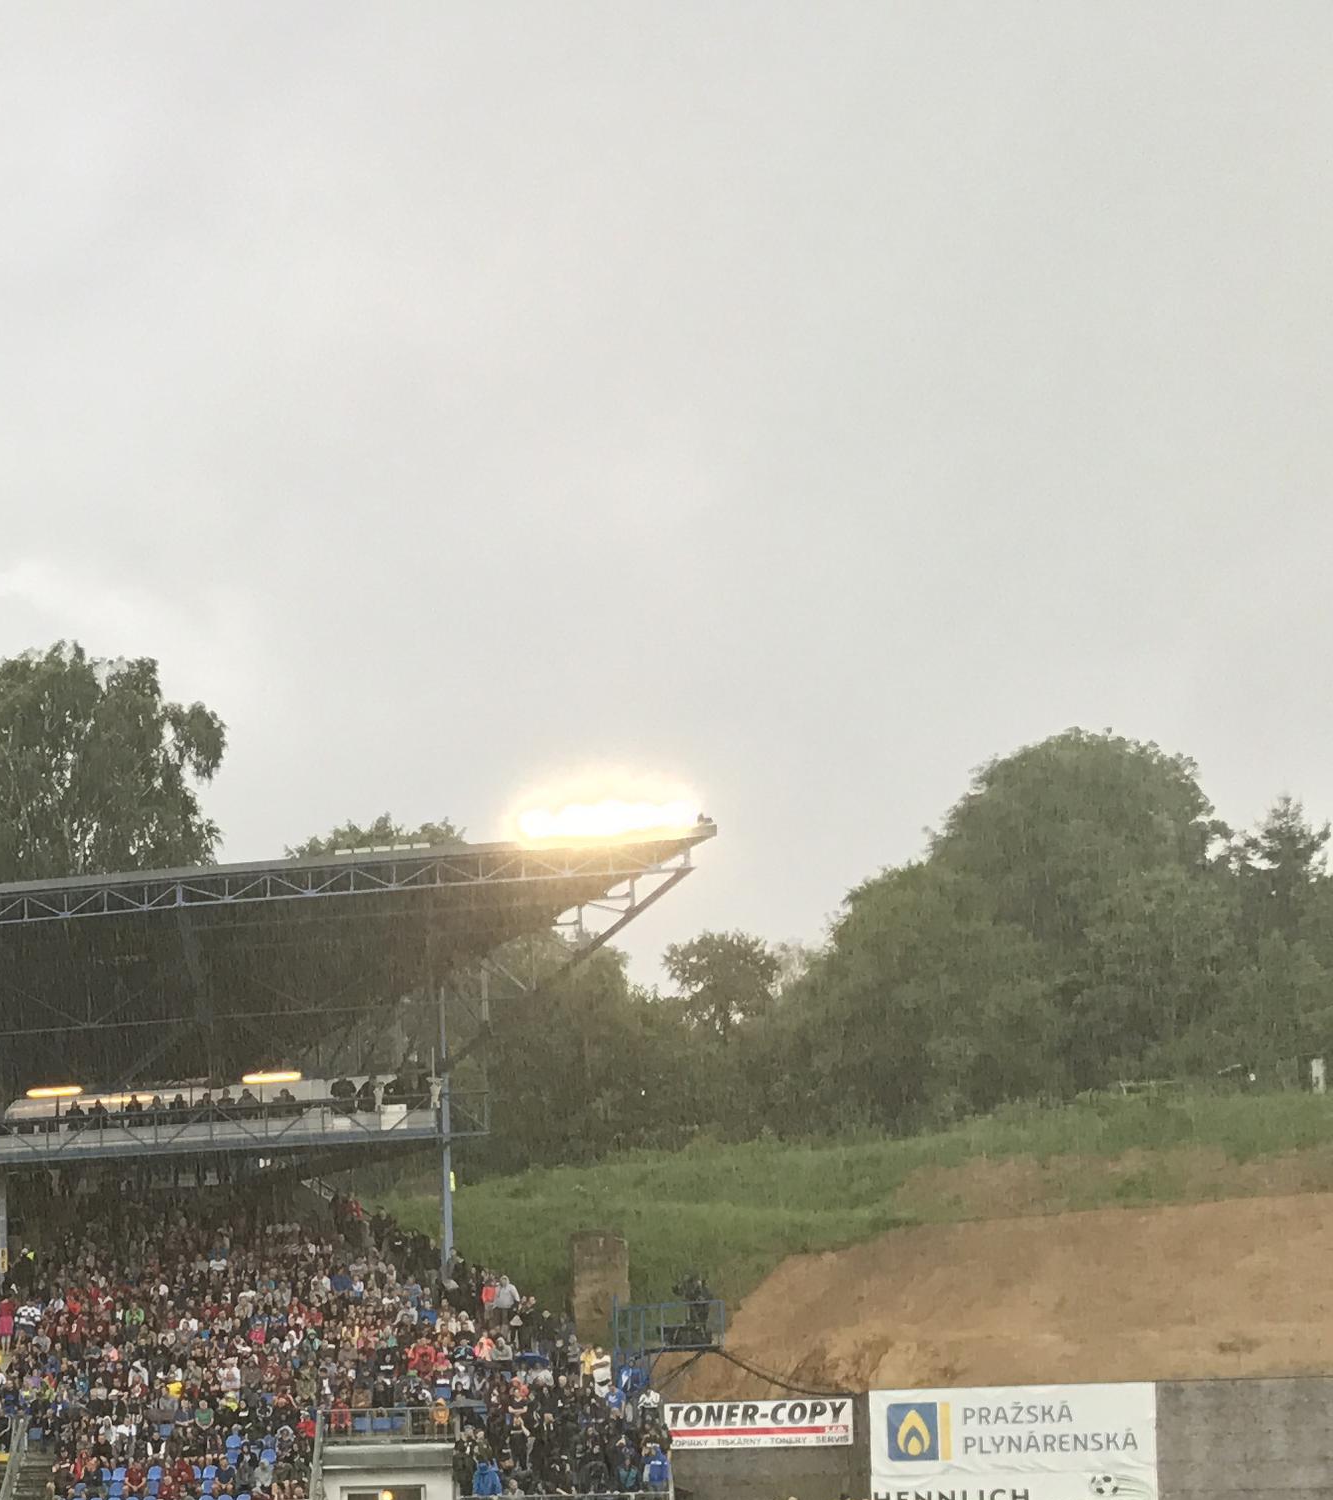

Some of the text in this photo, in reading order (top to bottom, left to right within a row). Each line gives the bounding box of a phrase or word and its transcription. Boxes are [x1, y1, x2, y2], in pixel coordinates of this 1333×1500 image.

[669, 1401, 847, 1427] TONER-COPY
[962, 1401, 1073, 1425] PRAŽSKÁ
[815, 1435, 849, 1443] SERVIS
[963, 1428, 1139, 1454] PLYNÁRENSKÁ
